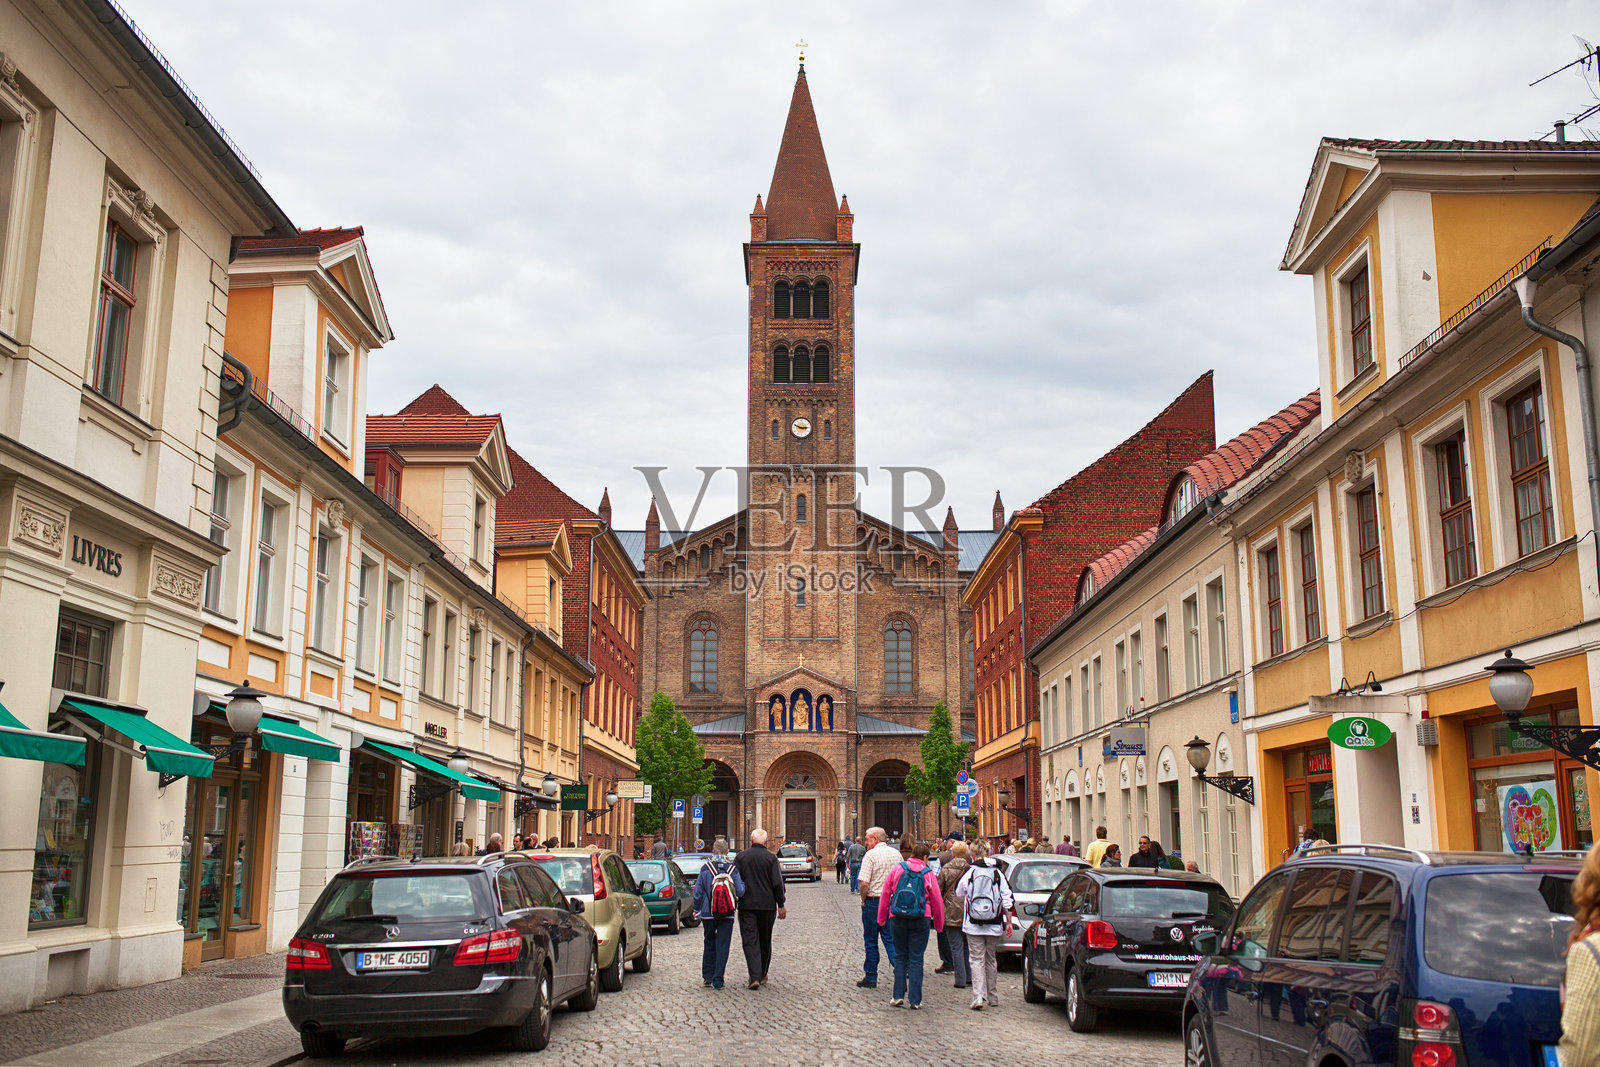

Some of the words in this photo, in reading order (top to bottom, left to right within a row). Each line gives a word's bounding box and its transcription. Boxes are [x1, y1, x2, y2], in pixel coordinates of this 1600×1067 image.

[72, 535, 122, 577] LIVRES
[1114, 740, 1143, 750] Strauss
[675, 801, 682, 810] P
[960, 795, 966, 806] P
[694, 808, 700, 817] P
[364, 954, 372, 966] B
[380, 953, 396, 965] ME
[398, 952, 428, 965] 4050
[1156, 973, 1169, 983] PM
[1175, 974, 1187, 984] NL
